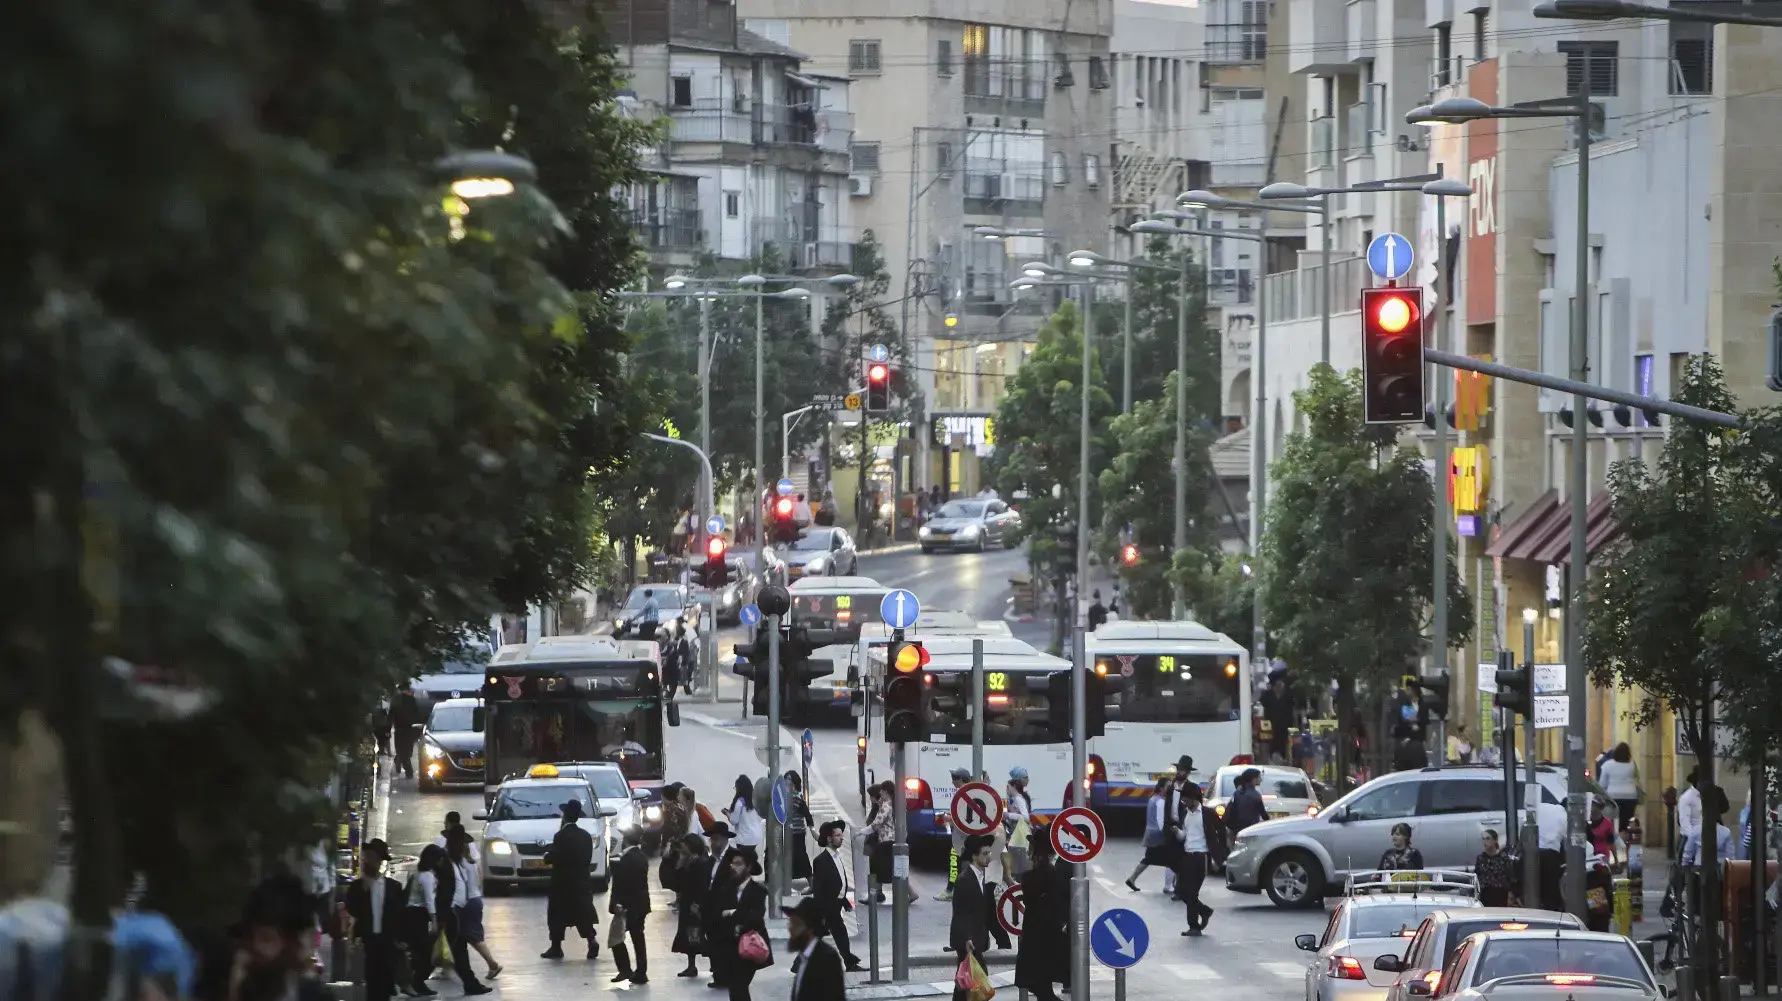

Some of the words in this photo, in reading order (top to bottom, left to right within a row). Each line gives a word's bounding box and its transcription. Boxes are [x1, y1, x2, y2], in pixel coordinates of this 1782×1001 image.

[1469, 157, 1496, 238] FOX
[1159, 655, 1174, 672] 34
[989, 672, 1005, 690] 92
[1535, 715, 1564, 724] chiezer
